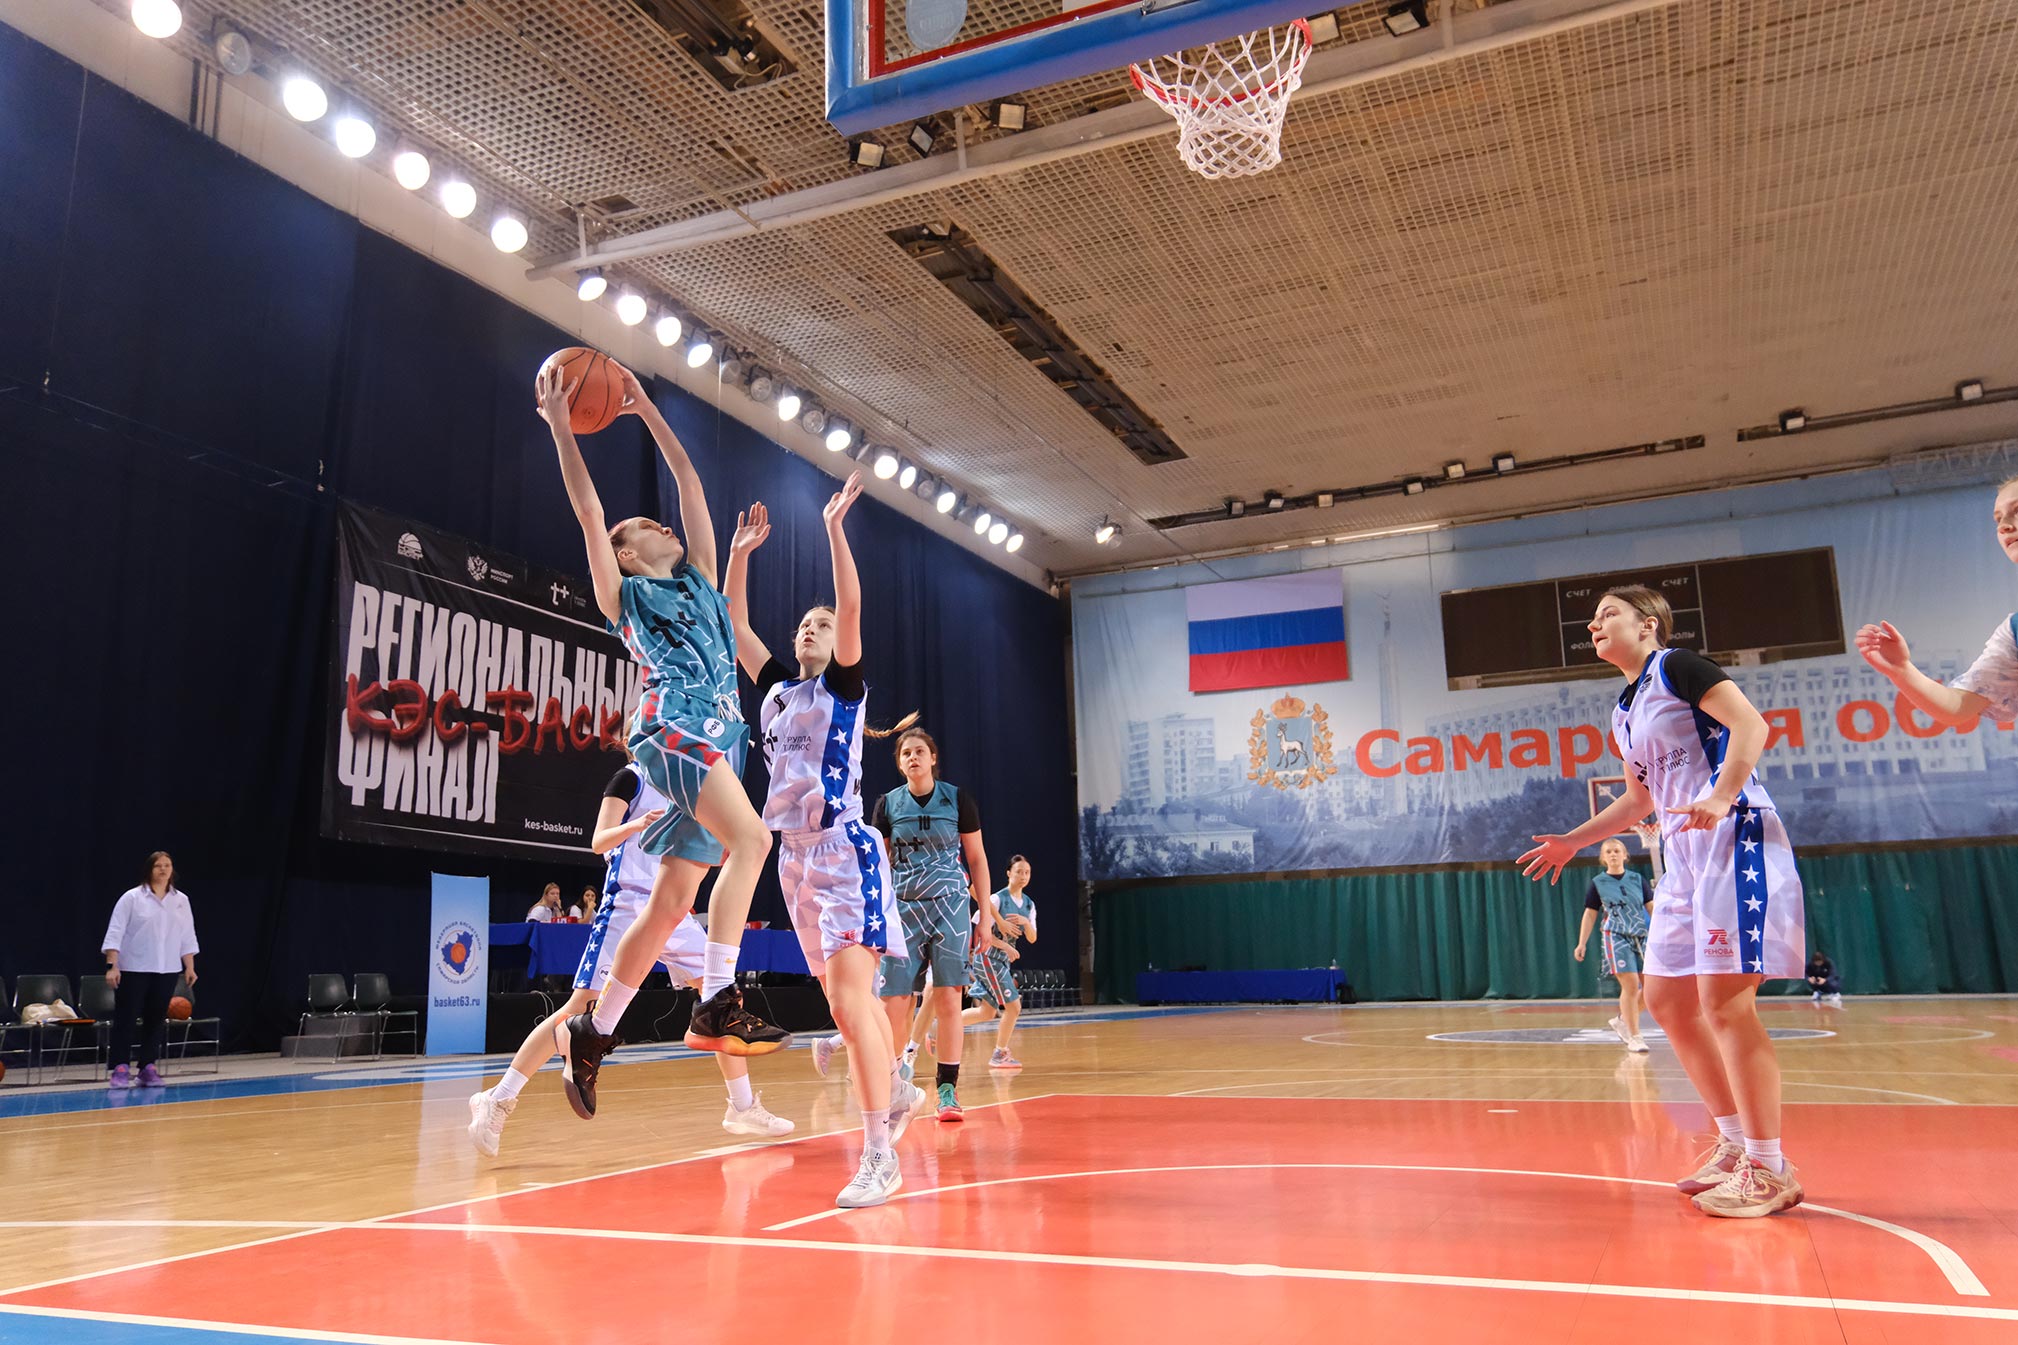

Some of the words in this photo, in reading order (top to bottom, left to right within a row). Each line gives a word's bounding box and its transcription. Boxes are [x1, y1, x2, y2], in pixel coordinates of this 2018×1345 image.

[1662, 577, 1689, 587] СЧЕТ
[1566, 588, 1591, 598] СЧЕТ
[1355, 708, 1805, 779] Самаря
[338, 706, 499, 824] ФИНАЛ
[524, 818, 583, 836] kes-basket.ru
[918, 815, 931, 831] 10
[434, 996, 481, 1008] basket63.ru
